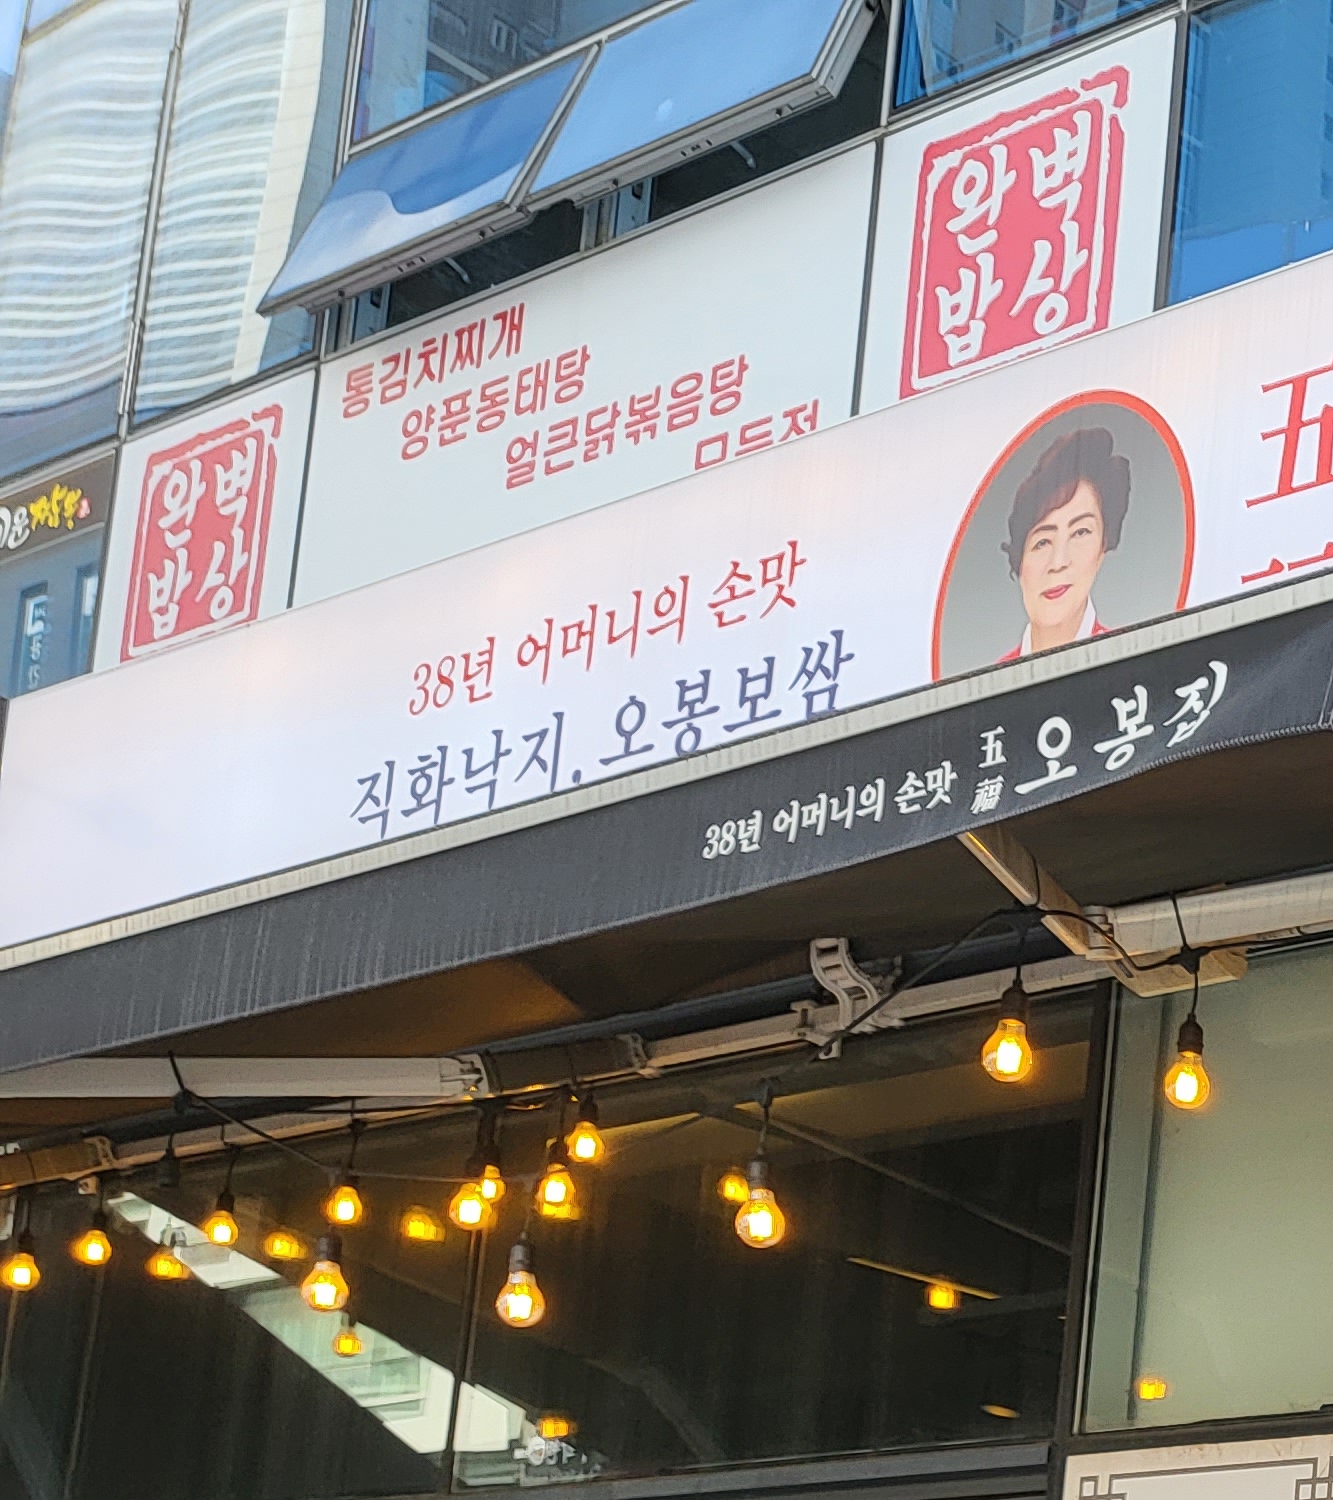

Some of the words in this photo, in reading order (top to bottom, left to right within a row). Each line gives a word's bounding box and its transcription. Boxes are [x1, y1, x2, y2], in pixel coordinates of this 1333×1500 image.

[946, 110, 1092, 256] 완벽
[935, 219, 1090, 367] 밥상
[342, 302, 526, 419] 통김치찌개
[401, 345, 591, 461] 양푼동태탕
[505, 354, 750, 490] 얼큰닭볶음탕
[157, 449, 251, 549] 완벽
[147, 525, 250, 640] 밥상
[408, 634, 497, 717] 38년
[516, 574, 689, 687] 어머니의
[706, 539, 808, 628] 손맛
[600, 627, 857, 768] 오봉보쌈
[1014, 660, 1229, 797] 오봉집
[701, 810, 763, 861] 38년
[771, 777, 886, 844] 어머니의
[893, 761, 959, 816] 손맛
[970, 725, 1008, 815] 五福
